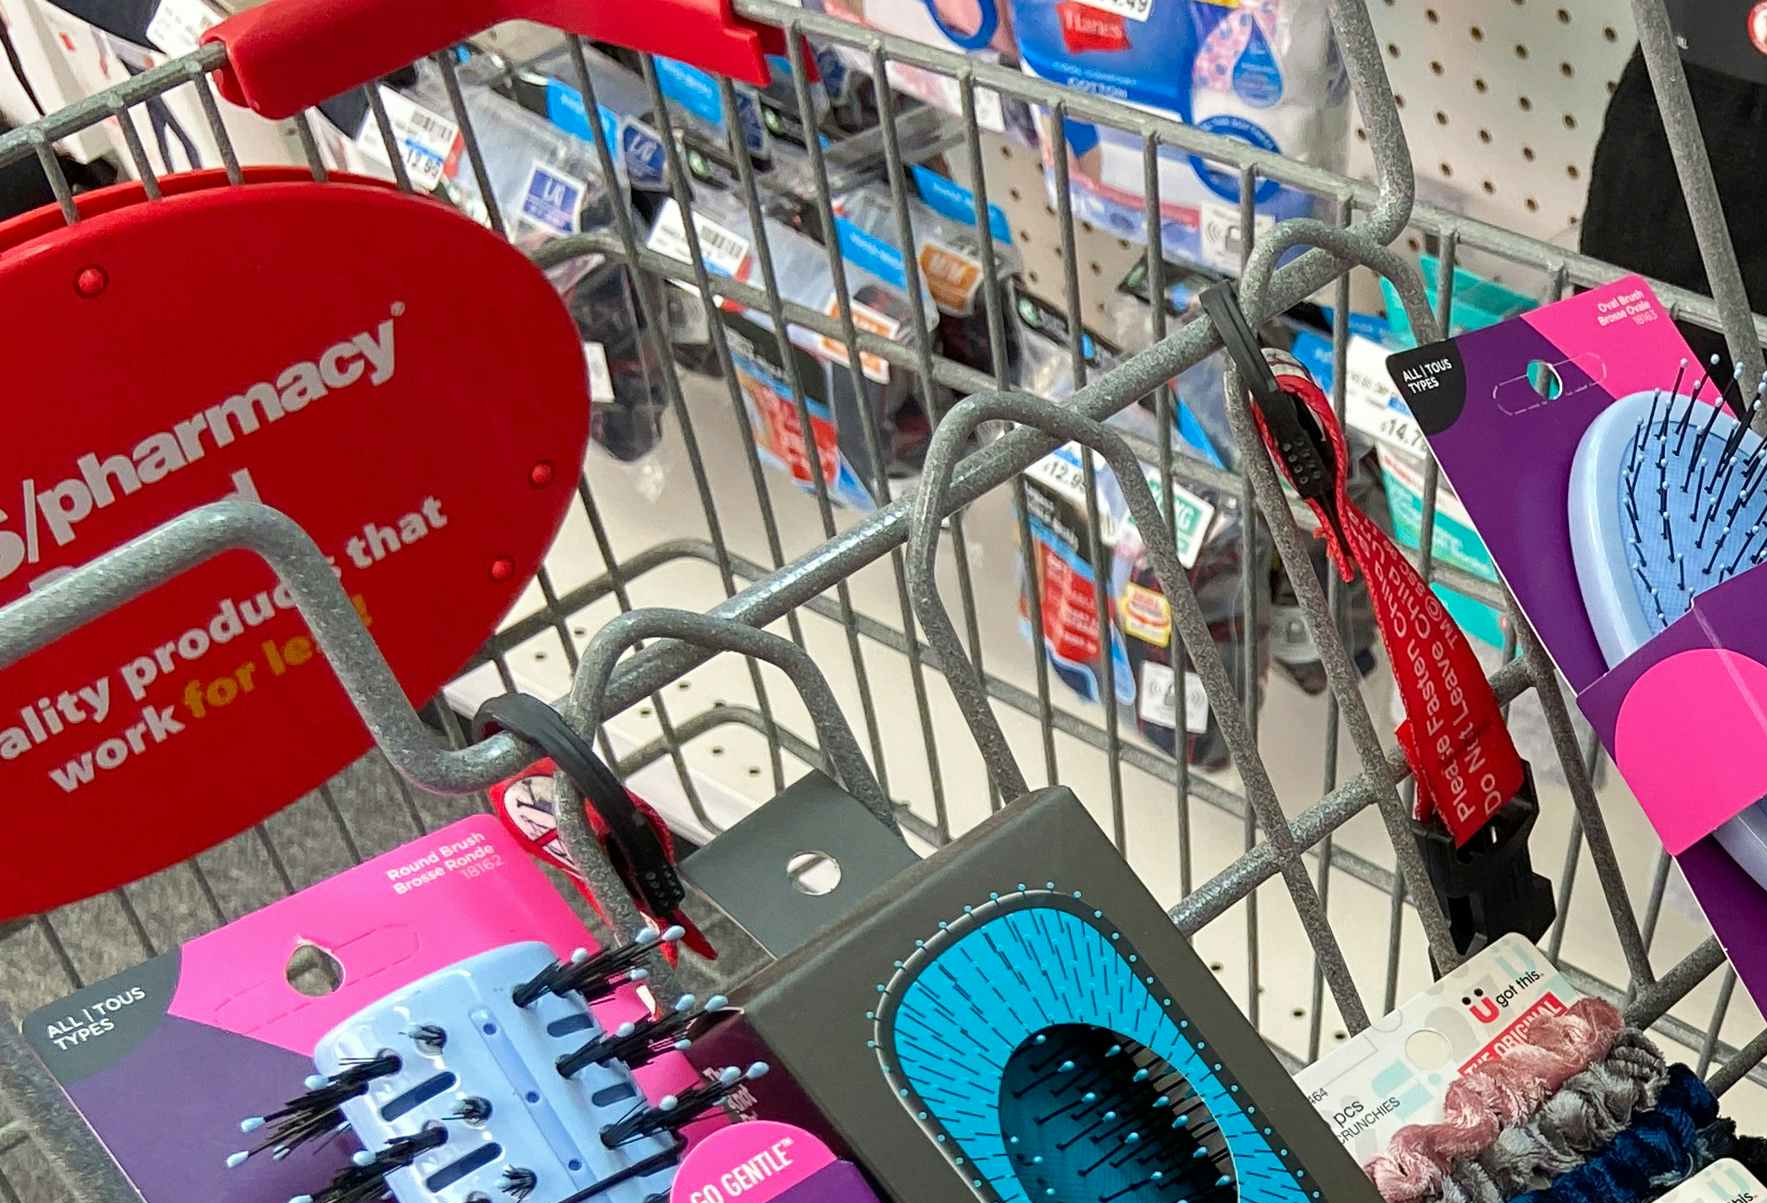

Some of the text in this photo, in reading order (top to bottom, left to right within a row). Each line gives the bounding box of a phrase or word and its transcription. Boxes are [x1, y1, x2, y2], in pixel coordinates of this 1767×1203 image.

[1402, 357, 1453, 384] ALL TOUS
[1407, 375, 1440, 395] TYPES
[345, 494, 449, 569] that
[1374, 559, 1408, 639] Child
[1388, 565, 1431, 640] Child
[1407, 638, 1444, 736] Fasten
[1431, 641, 1470, 727] Leave
[48, 661, 257, 793] work for
[1480, 772, 1502, 815] Do
[386, 831, 487, 881] Round Brush
[393, 844, 495, 896] Brosse Ronde
[46, 985, 146, 1040] ALL TOUS
[1495, 983, 1519, 1009] got
[52, 1017, 116, 1052] TYPES
[1332, 1100, 1365, 1129] pcs
[1337, 1096, 1401, 1145] CRUNCHIES
[718, 1142, 785, 1202] GENTLE
